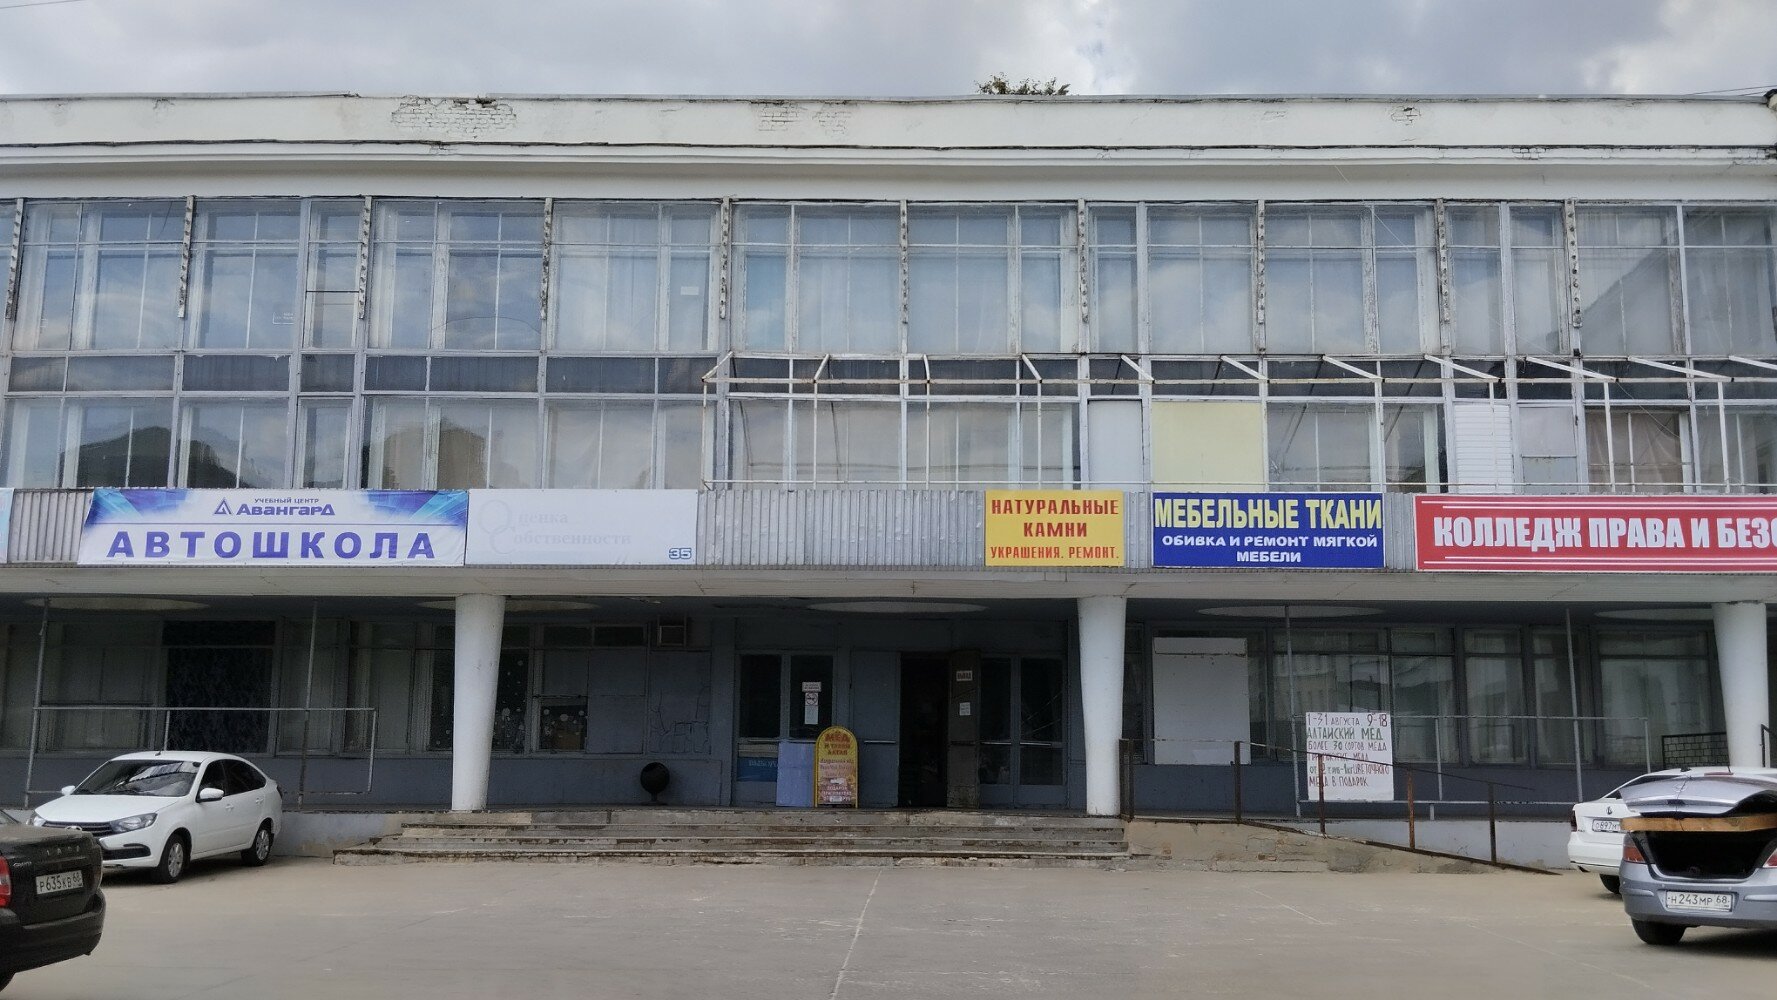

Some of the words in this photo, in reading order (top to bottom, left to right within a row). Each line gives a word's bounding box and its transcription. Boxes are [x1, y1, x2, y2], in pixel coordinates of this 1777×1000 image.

[254, 496, 292, 504] УЧЕБНЫЙ
[991, 499, 1119, 515] НАТУРАЛЬНЫЕ
[1154, 498, 1300, 529] МЕБЕЛЬНЫЕ
[1305, 499, 1383, 530] ТКАНИ
[1023, 522, 1088, 537] КАМНИ
[1433, 516, 1583, 552] КОЛЛЕДЖ
[1588, 517, 1686, 548] ПРАВА
[1690, 518, 1711, 548] И
[106, 531, 435, 559] АВТОШКОЛА
[1162, 535, 1226, 547] ОБИВКА
[1229, 536, 1241, 547] И
[1244, 536, 1309, 547] РЕМОНТ
[1313, 534, 1378, 548] МЯГКОЙ
[668, 547, 692, 560] 35
[990, 546, 1064, 559] УКРАШЕНИЯ.
[1236, 551, 1302, 563] МЕБЕЛИ
[1330, 716, 1361, 726] АВГУСТА
[1308, 740, 1328, 751] БОЛЕЕ
[1333, 740, 1343, 751] 30
[1344, 741, 1365, 751] СОРТОВ
[1367, 742, 1387, 752] МЕДА
[1331, 776, 1338, 787] В
[1339, 776, 1369, 788] ПОДАРОК
